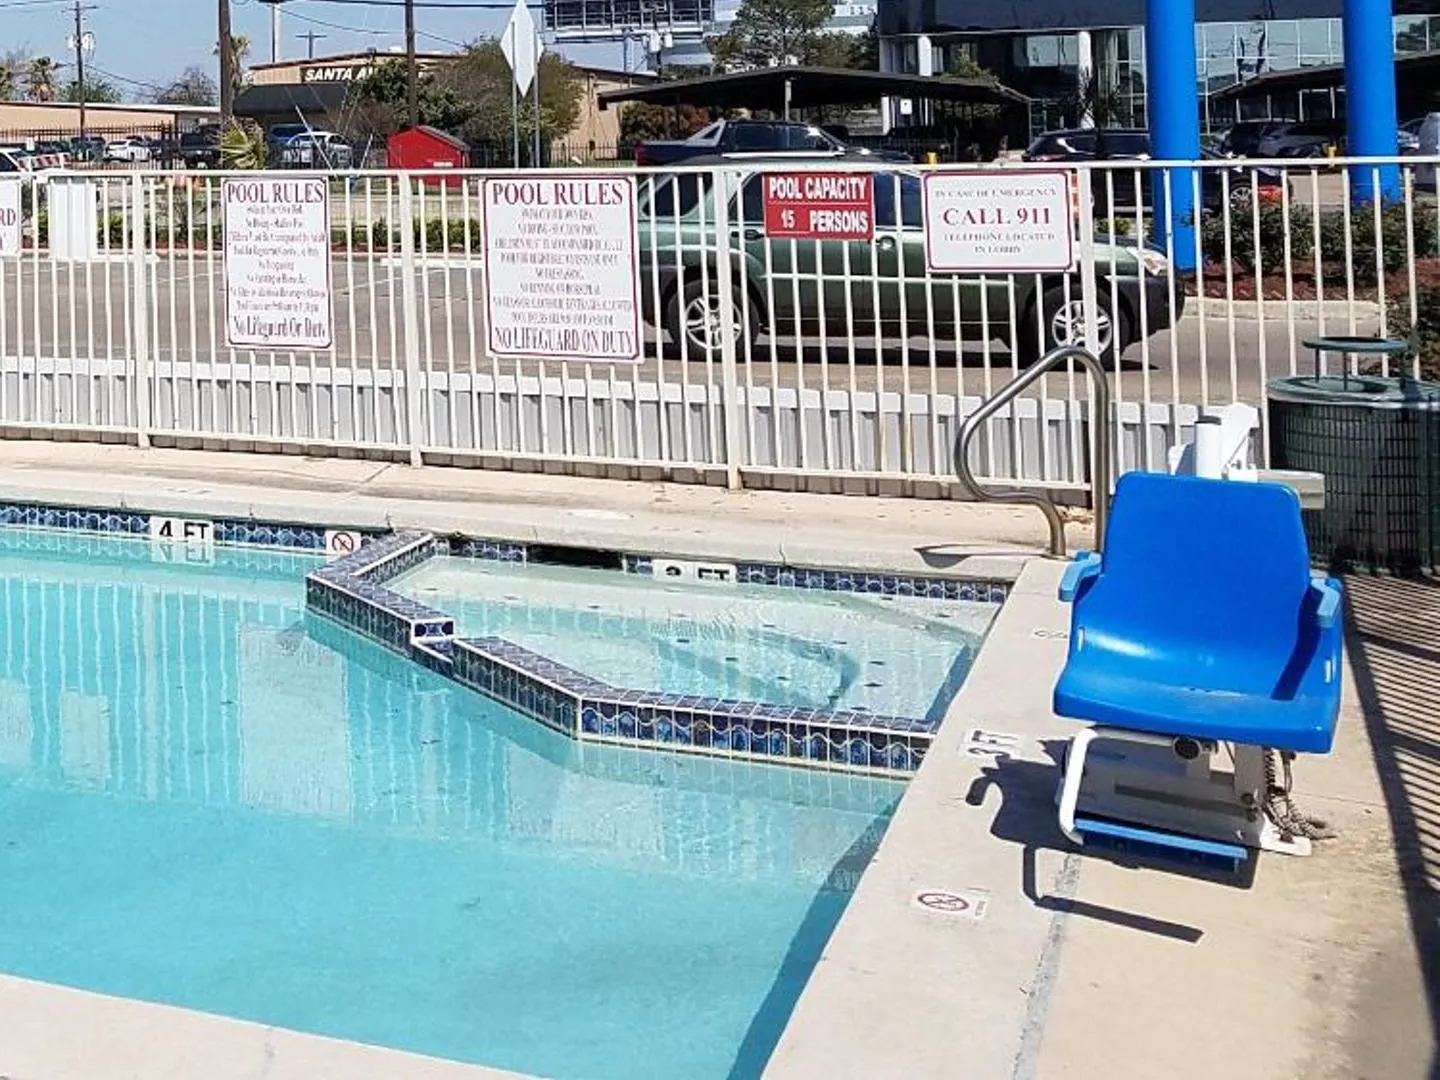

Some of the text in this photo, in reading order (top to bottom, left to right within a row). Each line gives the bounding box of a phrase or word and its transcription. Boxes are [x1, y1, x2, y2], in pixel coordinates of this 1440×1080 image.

[305, 67, 353, 81] SANTA
[228, 183, 324, 204] POOL RULES
[492, 182, 624, 206] POOL RULES
[769, 176, 866, 200] POOL CAPACITY
[781, 209, 869, 233] 15 PERSONS
[943, 207, 1051, 225] CALL 911
[495, 326, 634, 354] NO LIFEGUARD ON DUTY
[159, 521, 209, 540] 4 FT
